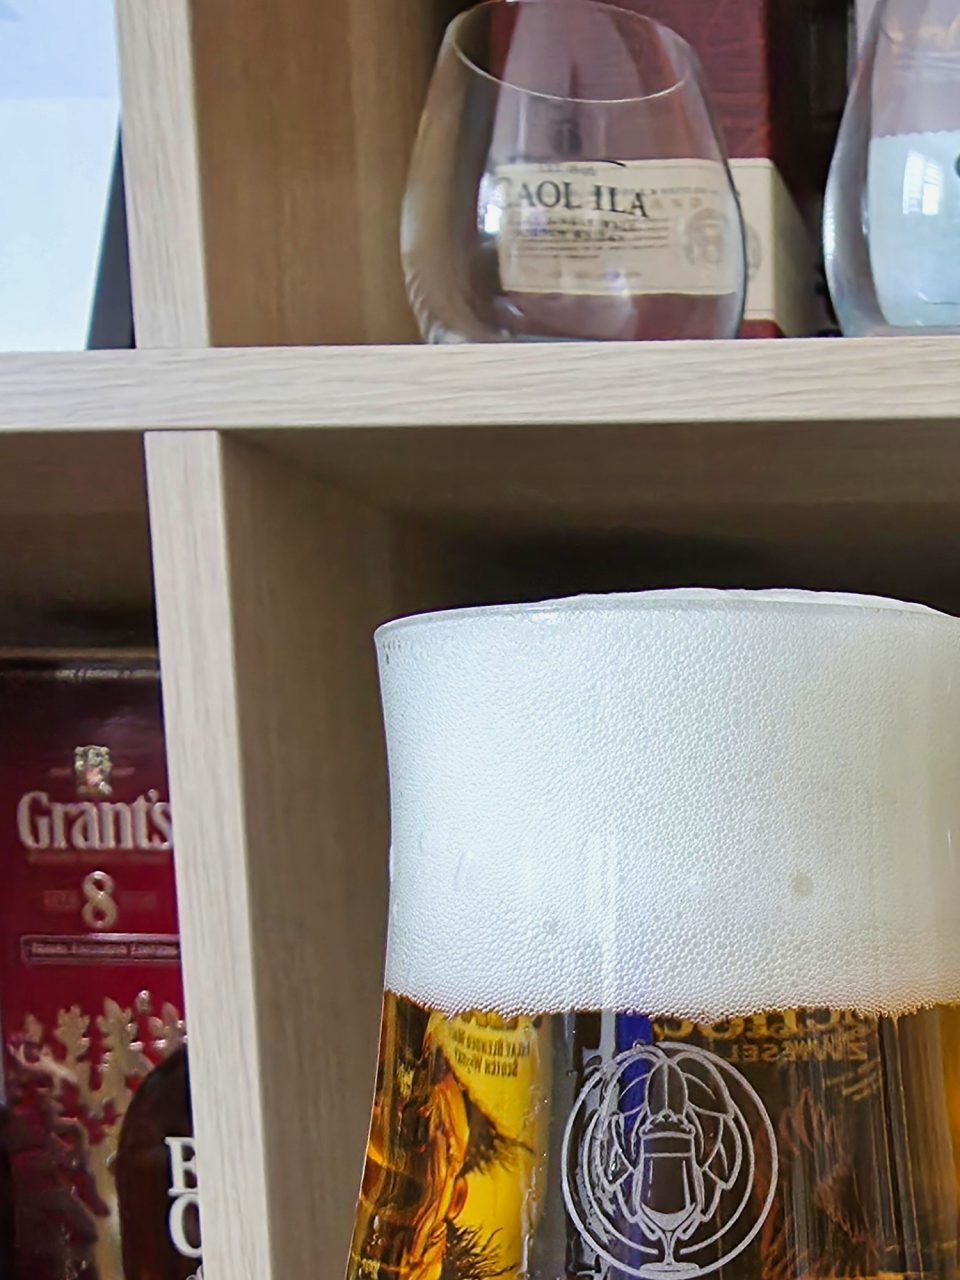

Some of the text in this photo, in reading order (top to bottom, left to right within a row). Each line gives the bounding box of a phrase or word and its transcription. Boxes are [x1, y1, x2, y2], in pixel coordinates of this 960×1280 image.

[592, 184, 648, 218] ILA
[16, 788, 173, 851] Grant's
[81, 870, 118, 930] 8
